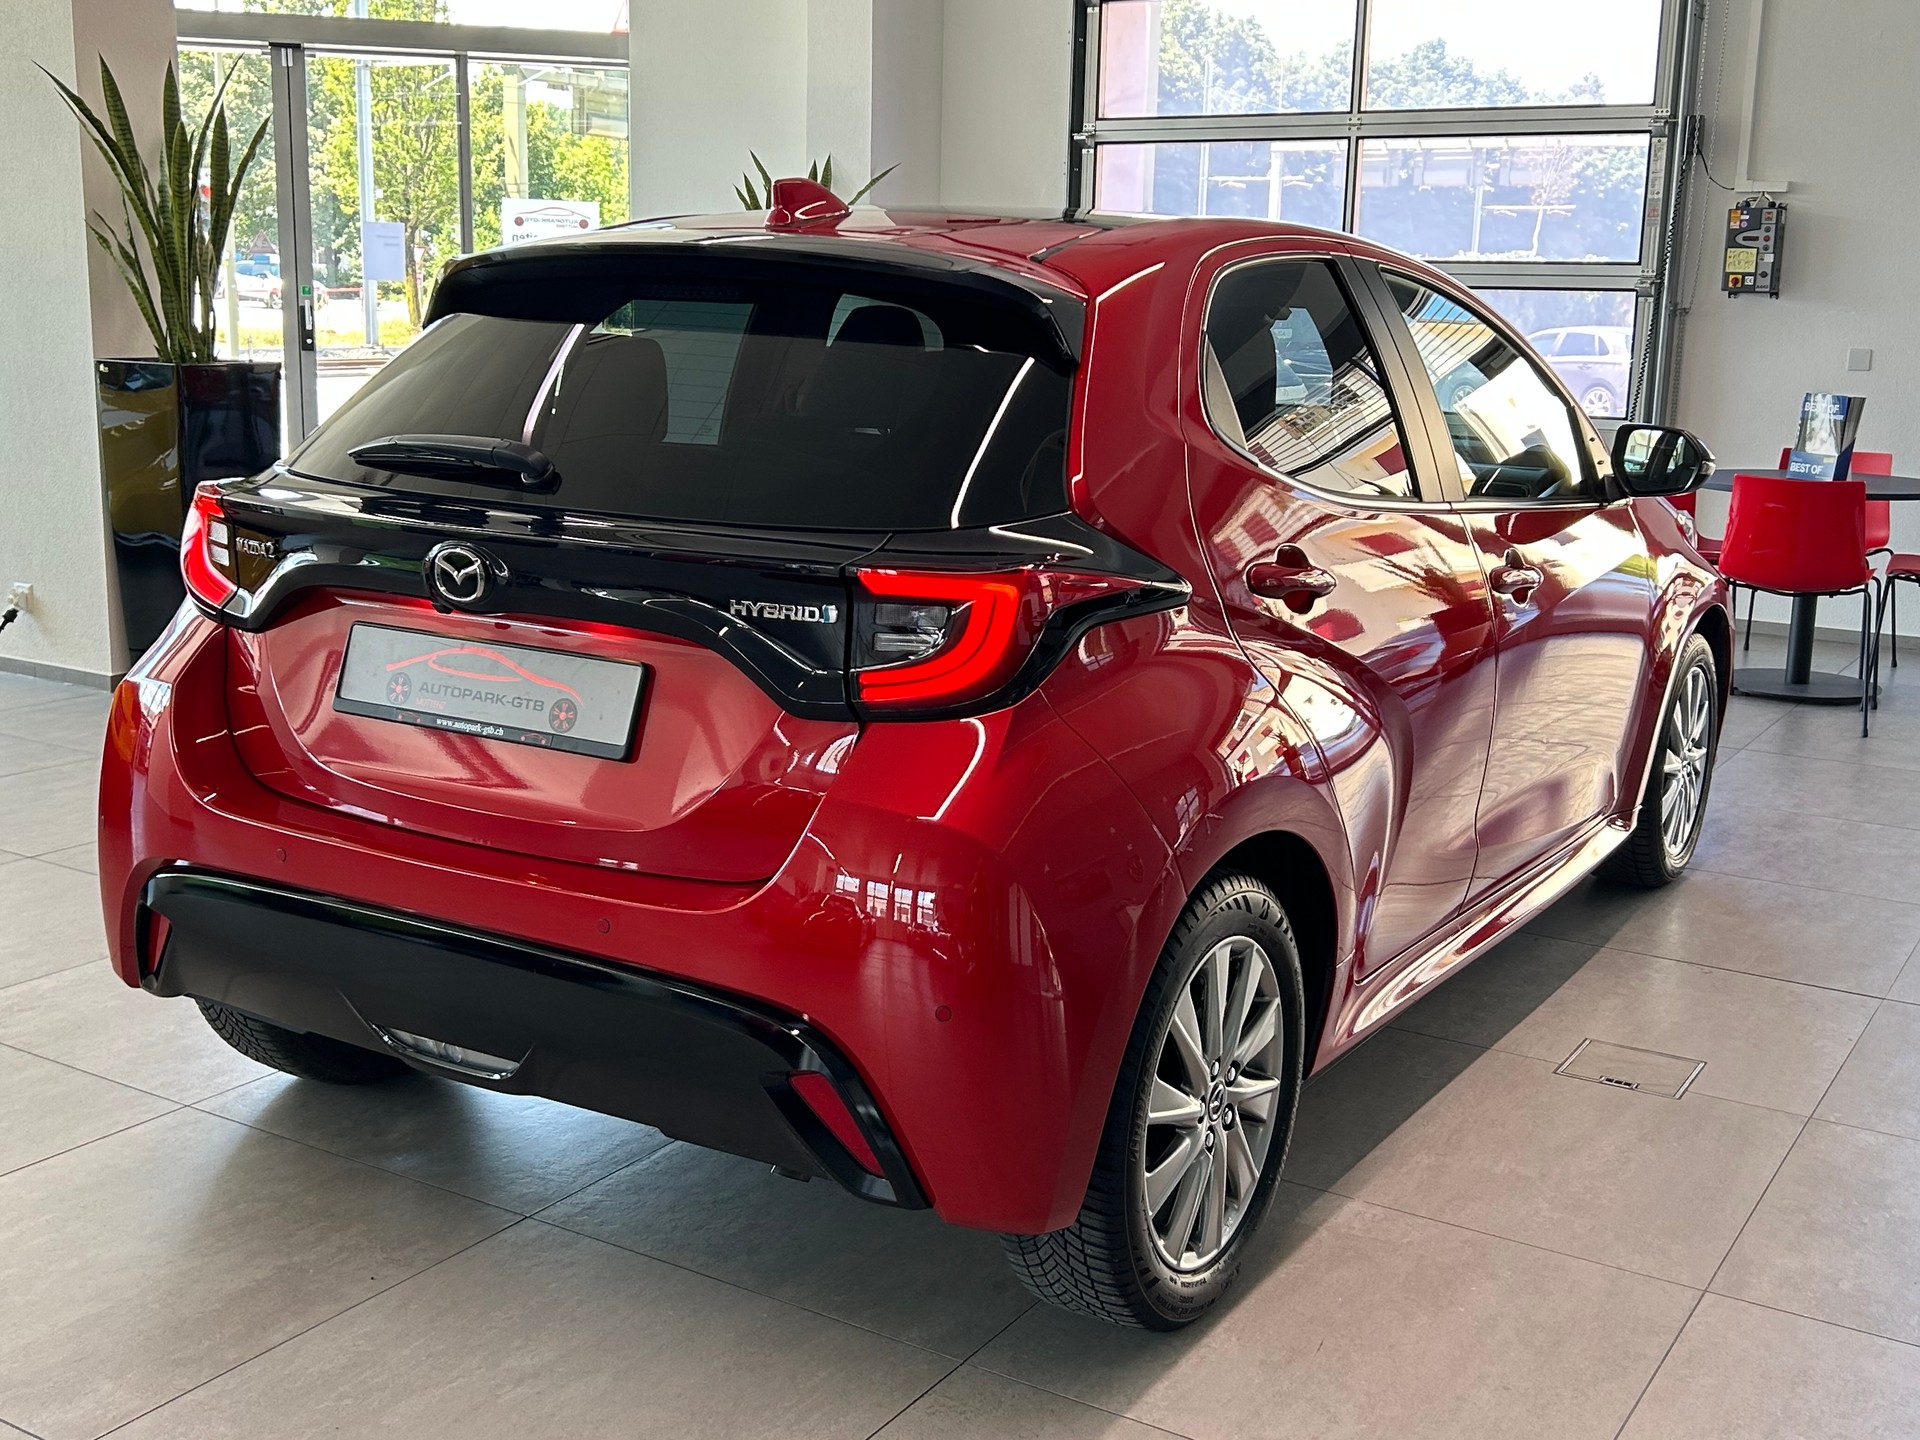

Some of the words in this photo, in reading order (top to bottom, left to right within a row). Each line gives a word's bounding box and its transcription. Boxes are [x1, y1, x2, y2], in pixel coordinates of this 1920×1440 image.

[1790, 463, 1810, 473] BEST
[1811, 465, 1823, 474] OF
[729, 600, 821, 623] HYBRID
[419, 682, 544, 711] AUTOPARK-GTB
[436, 717, 504, 736] www.autopark-gtb.ch
